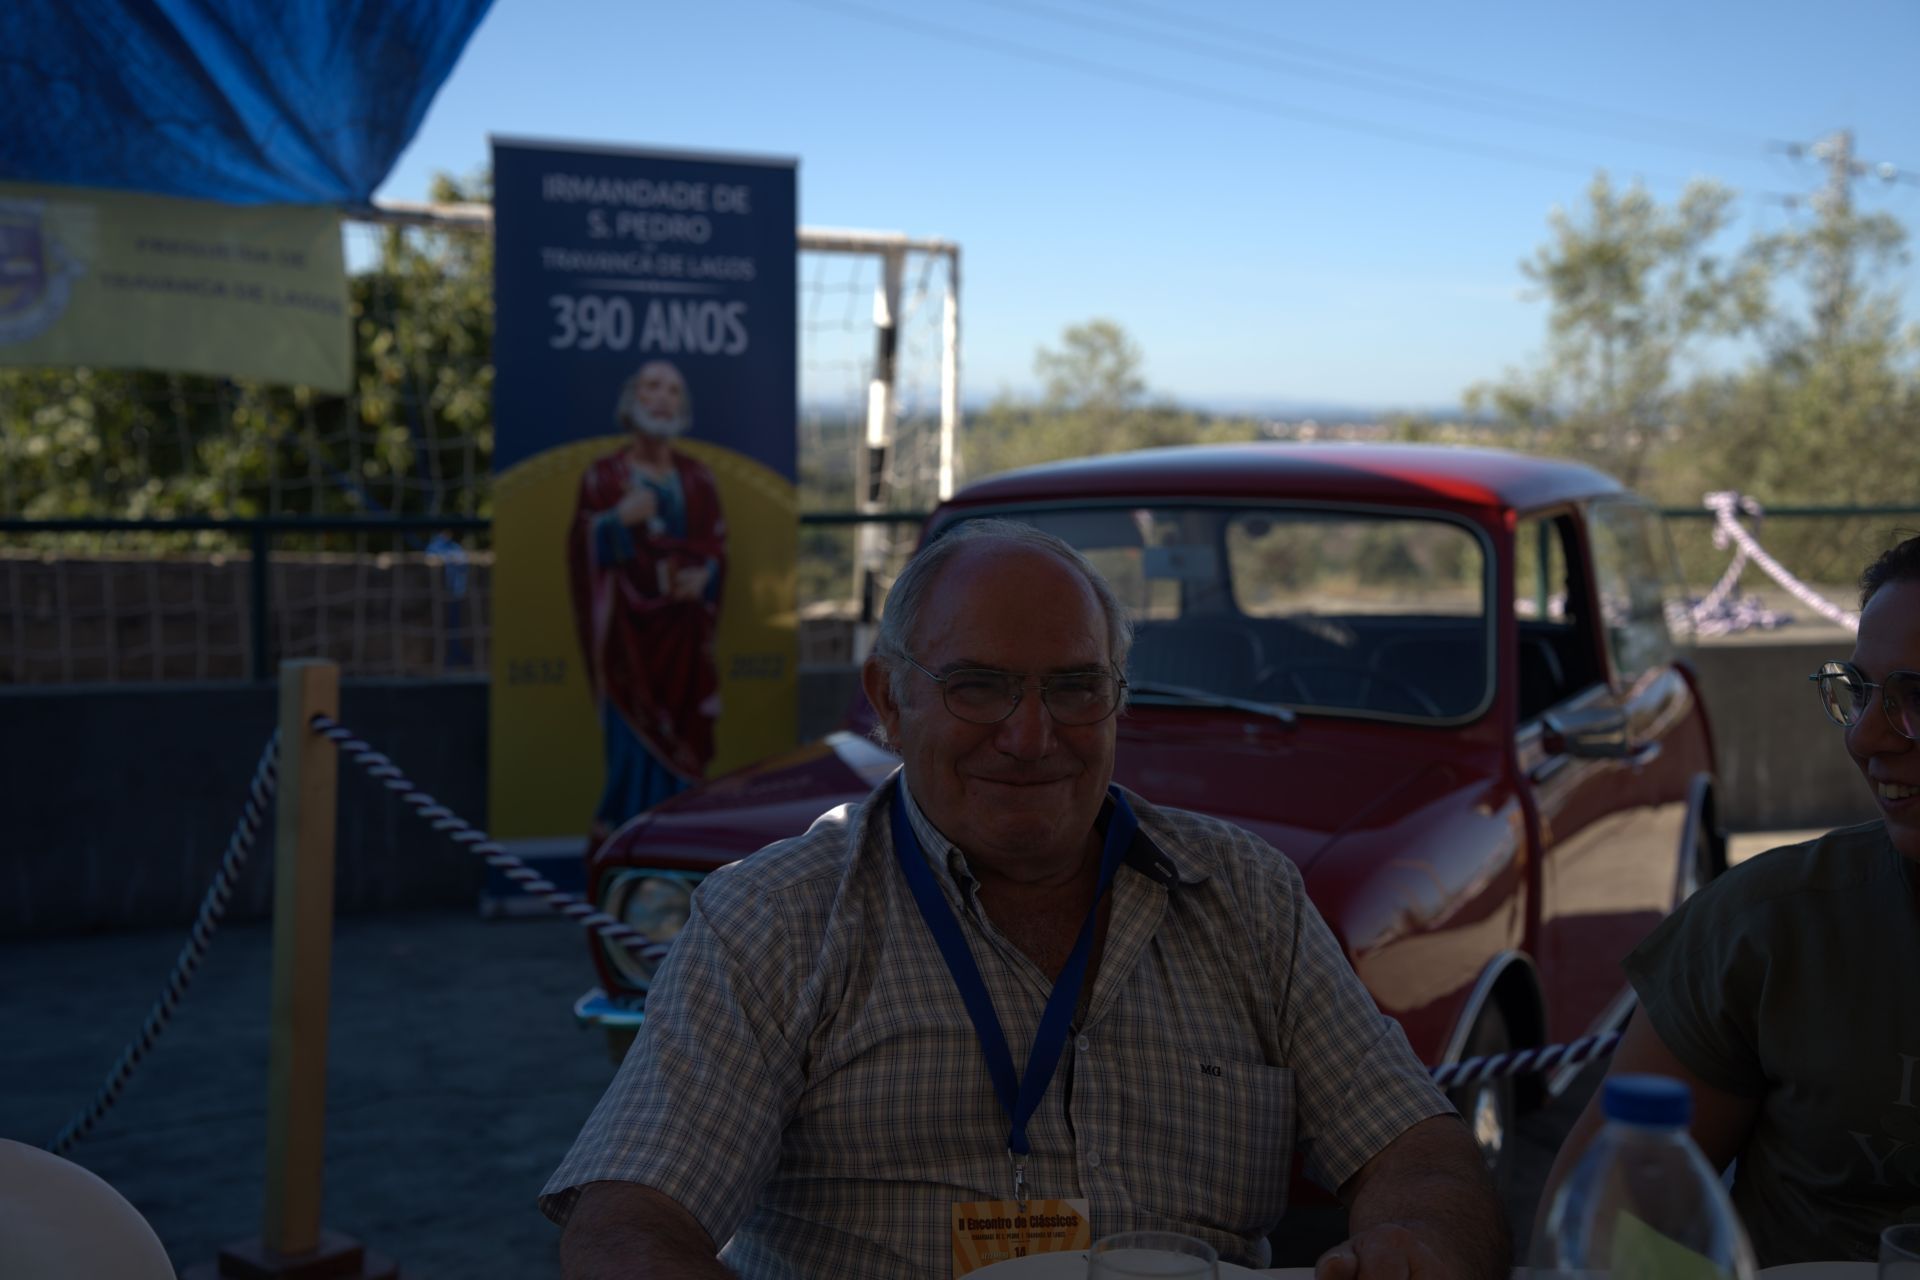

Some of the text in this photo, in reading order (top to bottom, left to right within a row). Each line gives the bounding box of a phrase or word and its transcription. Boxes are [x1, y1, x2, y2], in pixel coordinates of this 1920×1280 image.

[542, 173, 751, 214] IRMANDADE DE
[587, 208, 712, 244] S. PEDRO
[549, 295, 748, 355] 390 ANOS
[1200, 1064, 1220, 1076] MG
[968, 1216, 1012, 1230] Encontro
[1014, 1215, 1027, 1228] de
[1030, 1214, 1078, 1228] Clássicos
